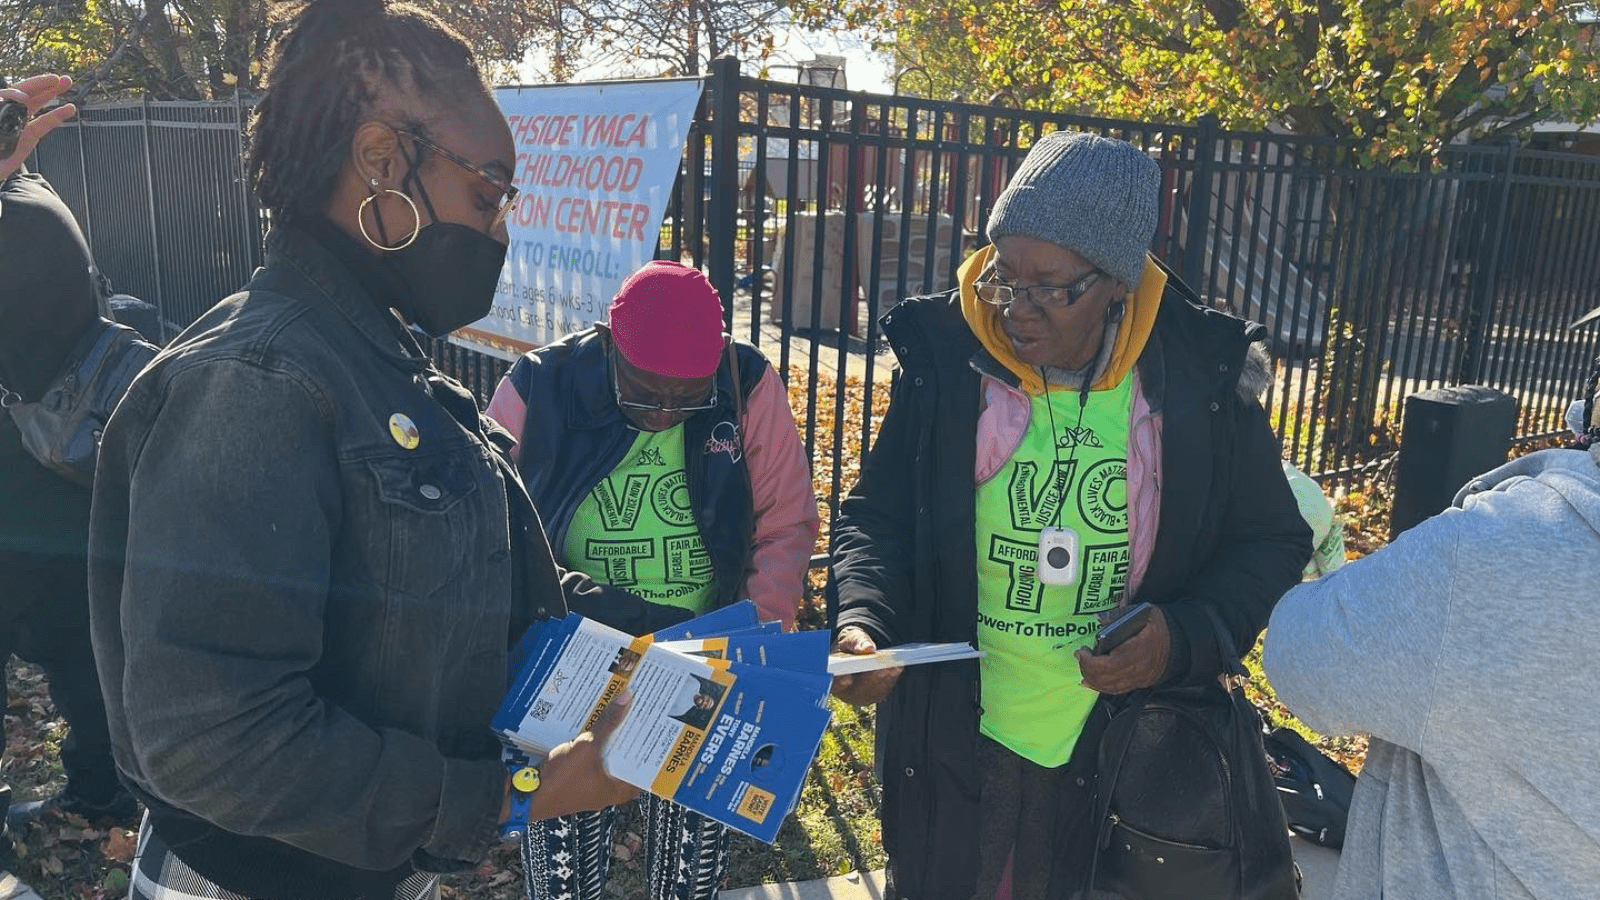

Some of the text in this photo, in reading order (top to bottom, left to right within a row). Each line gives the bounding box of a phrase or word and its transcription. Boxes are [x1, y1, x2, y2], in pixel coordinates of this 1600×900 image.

[507, 114, 649, 147] THSIDE YMCA
[511, 153, 643, 192] CHILDHOOD
[511, 193, 649, 241] ION CENTER
[524, 241, 543, 266] TO
[549, 245, 620, 279] ENROLL:
[523, 286, 545, 306] ages
[549, 286, 556, 305] 6
[560, 290, 593, 313] wks-3
[546, 312, 554, 331] 6
[663, 473, 687, 489] MATTE
[1015, 466, 1031, 526] ENVIRONMENTAL
[1087, 477, 1103, 504] LIVES
[619, 478, 641, 524] JUSTICE NOW
[661, 504, 684, 521] BLACK
[1035, 489, 1058, 526] JUSTICE
[1089, 503, 1117, 526] BLACK
[592, 545, 648, 556] AFFORDABLE
[670, 540, 690, 550] FAIR
[1092, 549, 1130, 563] FAIR A
[1015, 565, 1035, 606] HOUSING
[1086, 565, 1105, 602] LIVEABLE
[602, 680, 620, 704] TONY
[700, 714, 735, 764] EVERS
[728, 719, 741, 738] TONY
[739, 725, 761, 760] MANDELA
[666, 730, 695, 773] BARNES
[720, 722, 755, 775] BARNES
